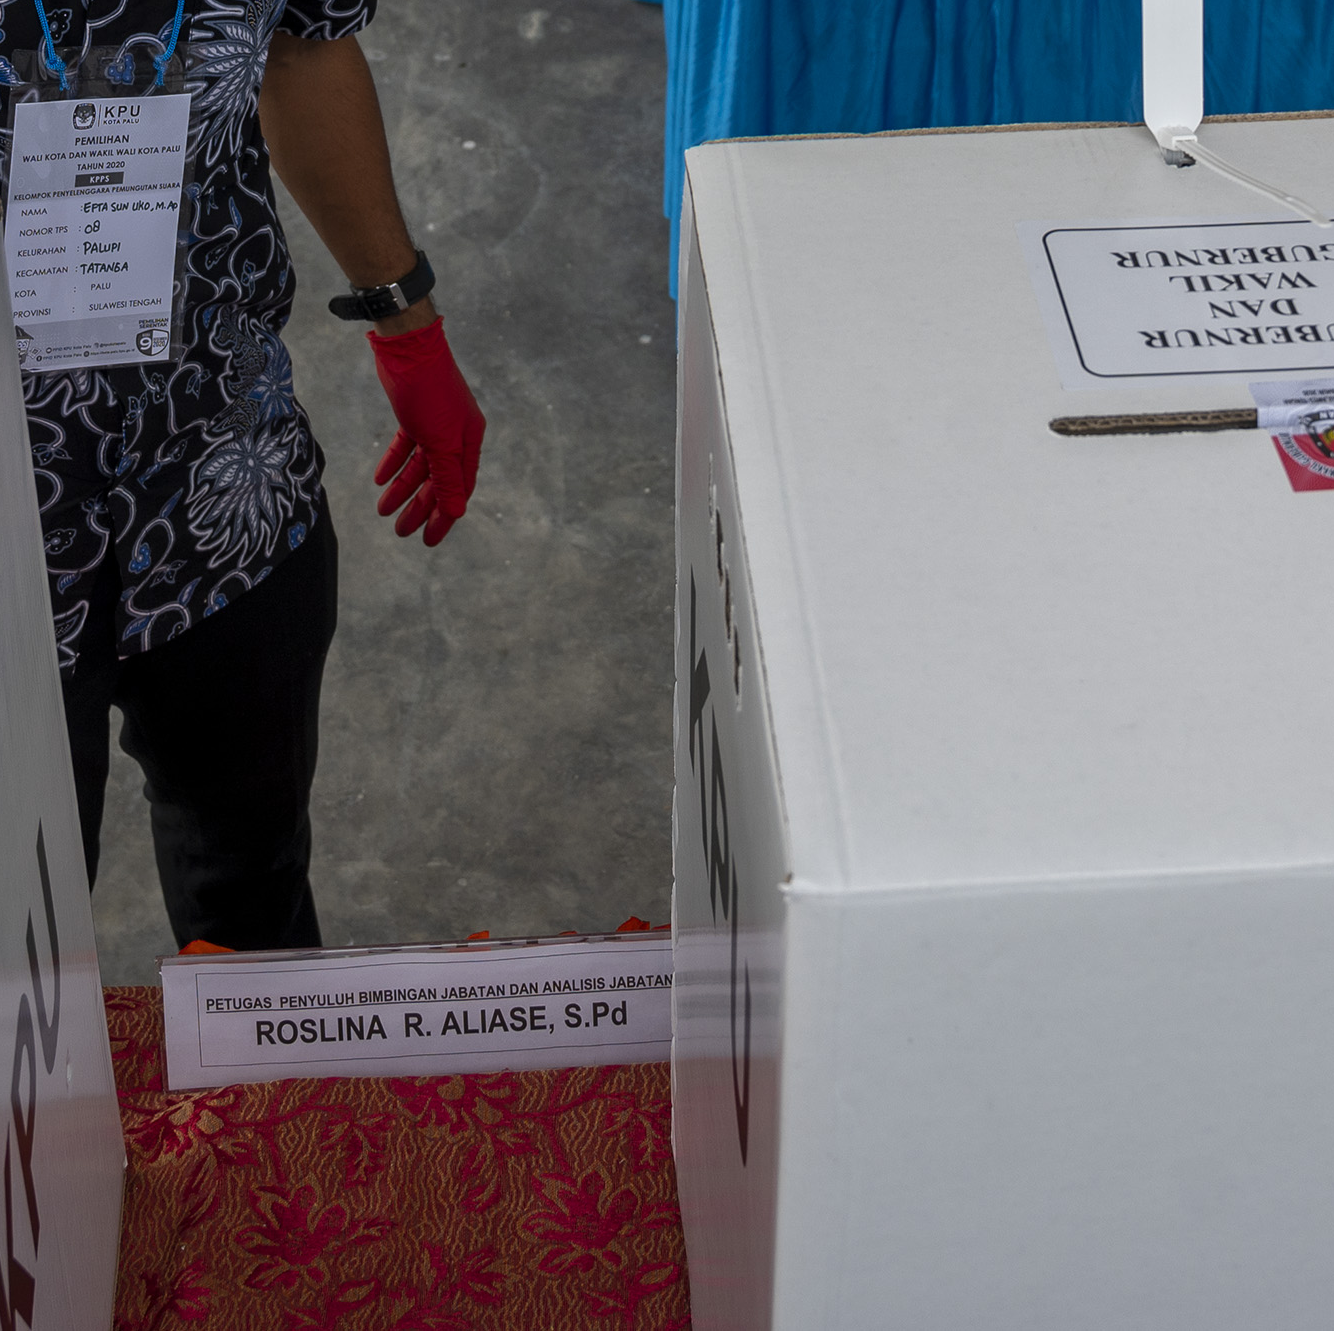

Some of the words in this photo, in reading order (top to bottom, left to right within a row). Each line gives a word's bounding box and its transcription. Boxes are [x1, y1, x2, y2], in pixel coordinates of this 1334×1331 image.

[105, 105, 141, 118] KPU
[75, 135, 130, 146] PEMILIHAN
[23, 155, 42, 163] WALI
[45, 153, 67, 161] KOTA
[89, 150, 114, 158] WAKIL
[117, 148, 135, 156] WALI
[138, 147, 159, 155] KOTA
[161, 145, 181, 153] PALU
[77, 163, 104, 171] TAHUN
[106, 161, 125, 169] 2020
[14, 192, 51, 201] KELOMPOK
[53, 187, 110, 197] PENYELENGGARA
[112, 184, 158, 193] PEMUNGUTAN
[159, 182, 181, 190] SUARA
[21, 209, 48, 217] NAMA
[111, 202, 129, 212] SUN
[19, 228, 53, 237] NOMOR
[55, 226, 68, 234] TPS
[84, 220, 101, 234] 08
[17, 246, 66, 257] KELURAHAN
[83, 241, 121, 255] PALUPI
[16, 266, 68, 278] KECAMATAN
[14, 290, 37, 298] KOTA
[91, 282, 111, 291] PALU
[1169, 271, 1318, 293] WAKIL
[13, 309, 51, 319] PROVINSI
[89, 302, 127, 311] SULAWESI
[129, 298, 162, 308] TENGAH
[1208, 298, 1302, 319] DAN
[140, 339, 151, 350] 9
[690, 564, 751, 1168] KPU
[206, 996, 272, 1012] PETUGAS
[279, 992, 355, 1008] PENYULUH
[359, 988, 437, 1004] BIMBINGAN
[441, 985, 506, 1001] JABATAN
[509, 982, 539, 997] DAN
[542, 977, 606, 994] ANALISIS
[609, 974, 673, 990] JABATAN
[255, 1014, 387, 1045] ROSLINA
[404, 1012, 432, 1037] R.
[441, 1004, 555, 1036] ALIASE,
[563, 1000, 628, 1029] S.Pd
